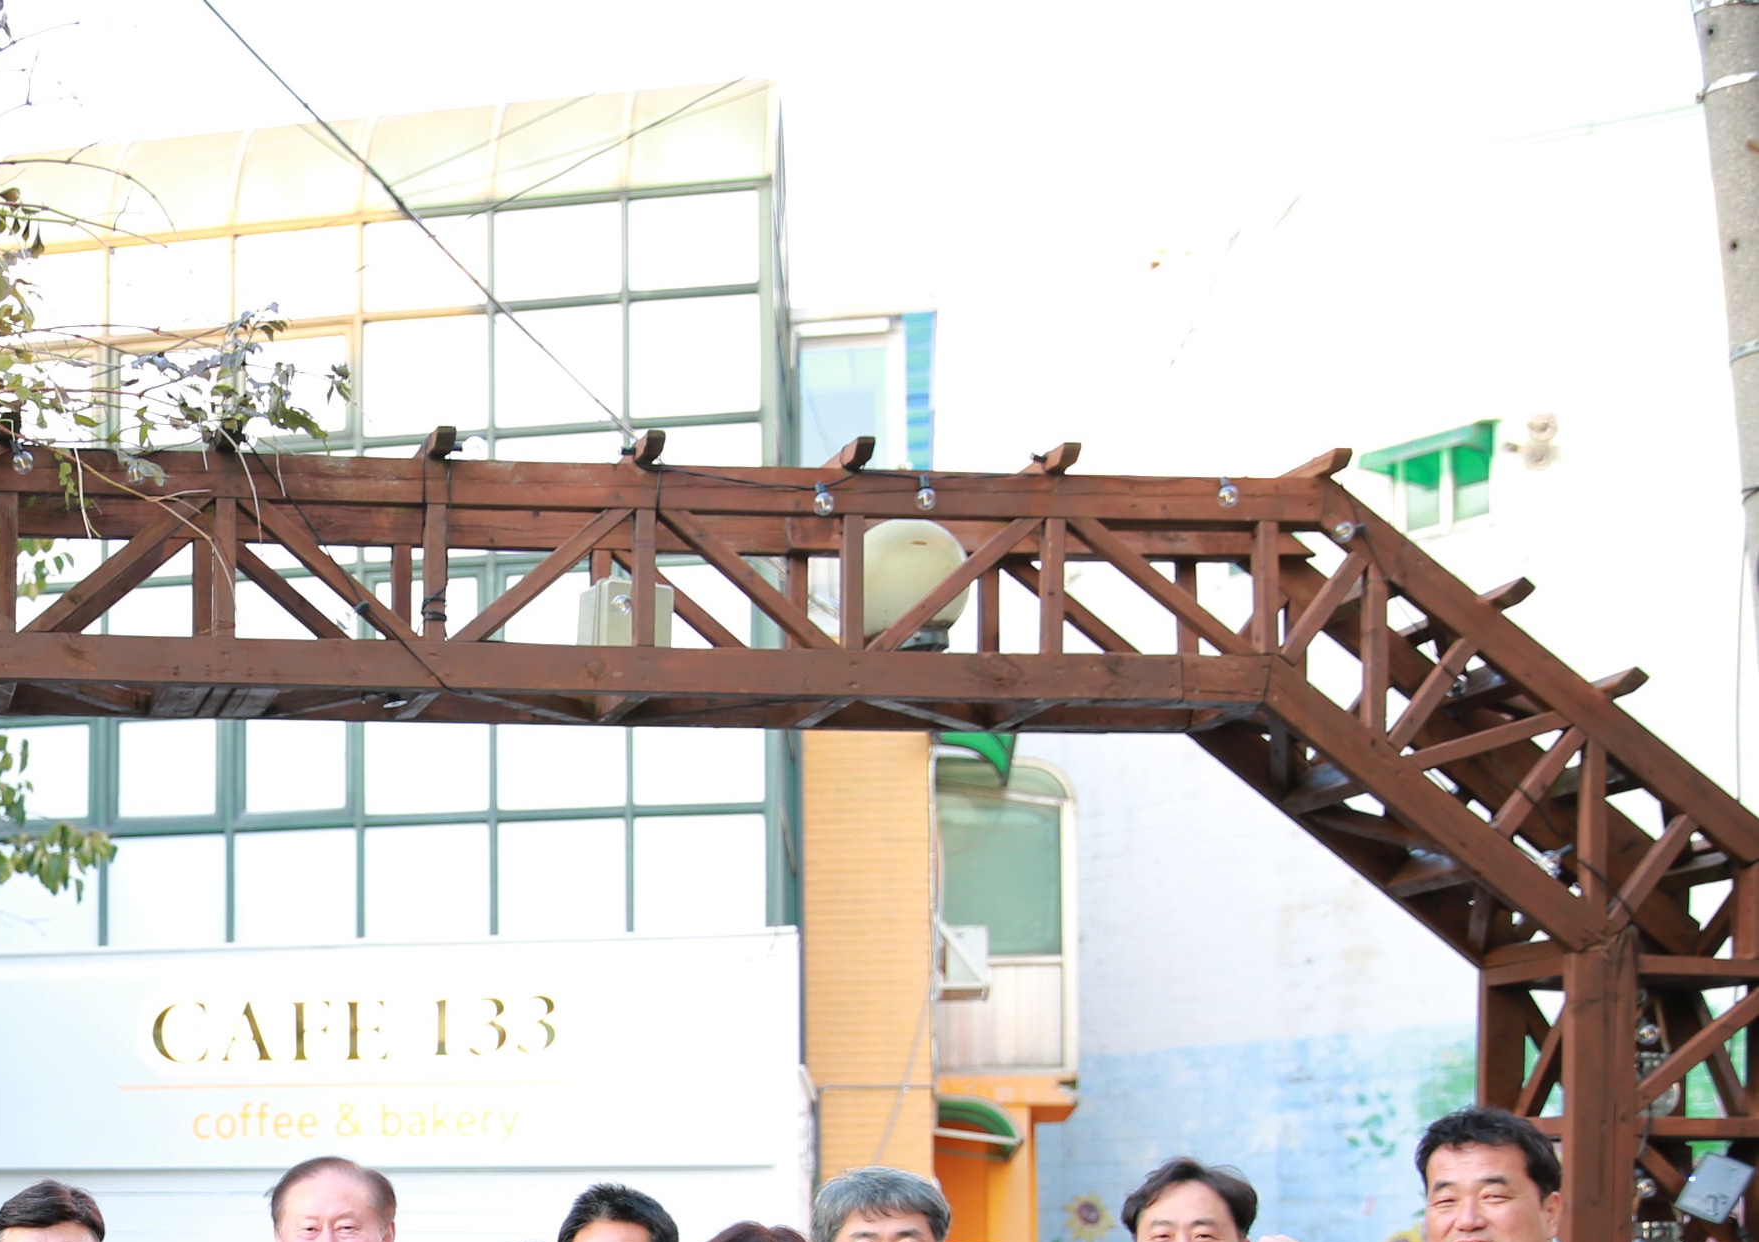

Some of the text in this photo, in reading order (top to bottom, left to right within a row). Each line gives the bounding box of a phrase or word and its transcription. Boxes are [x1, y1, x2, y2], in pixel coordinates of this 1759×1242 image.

[152, 995, 556, 1063] CAFE 133
[192, 1102, 520, 1142] coffee & bakery
